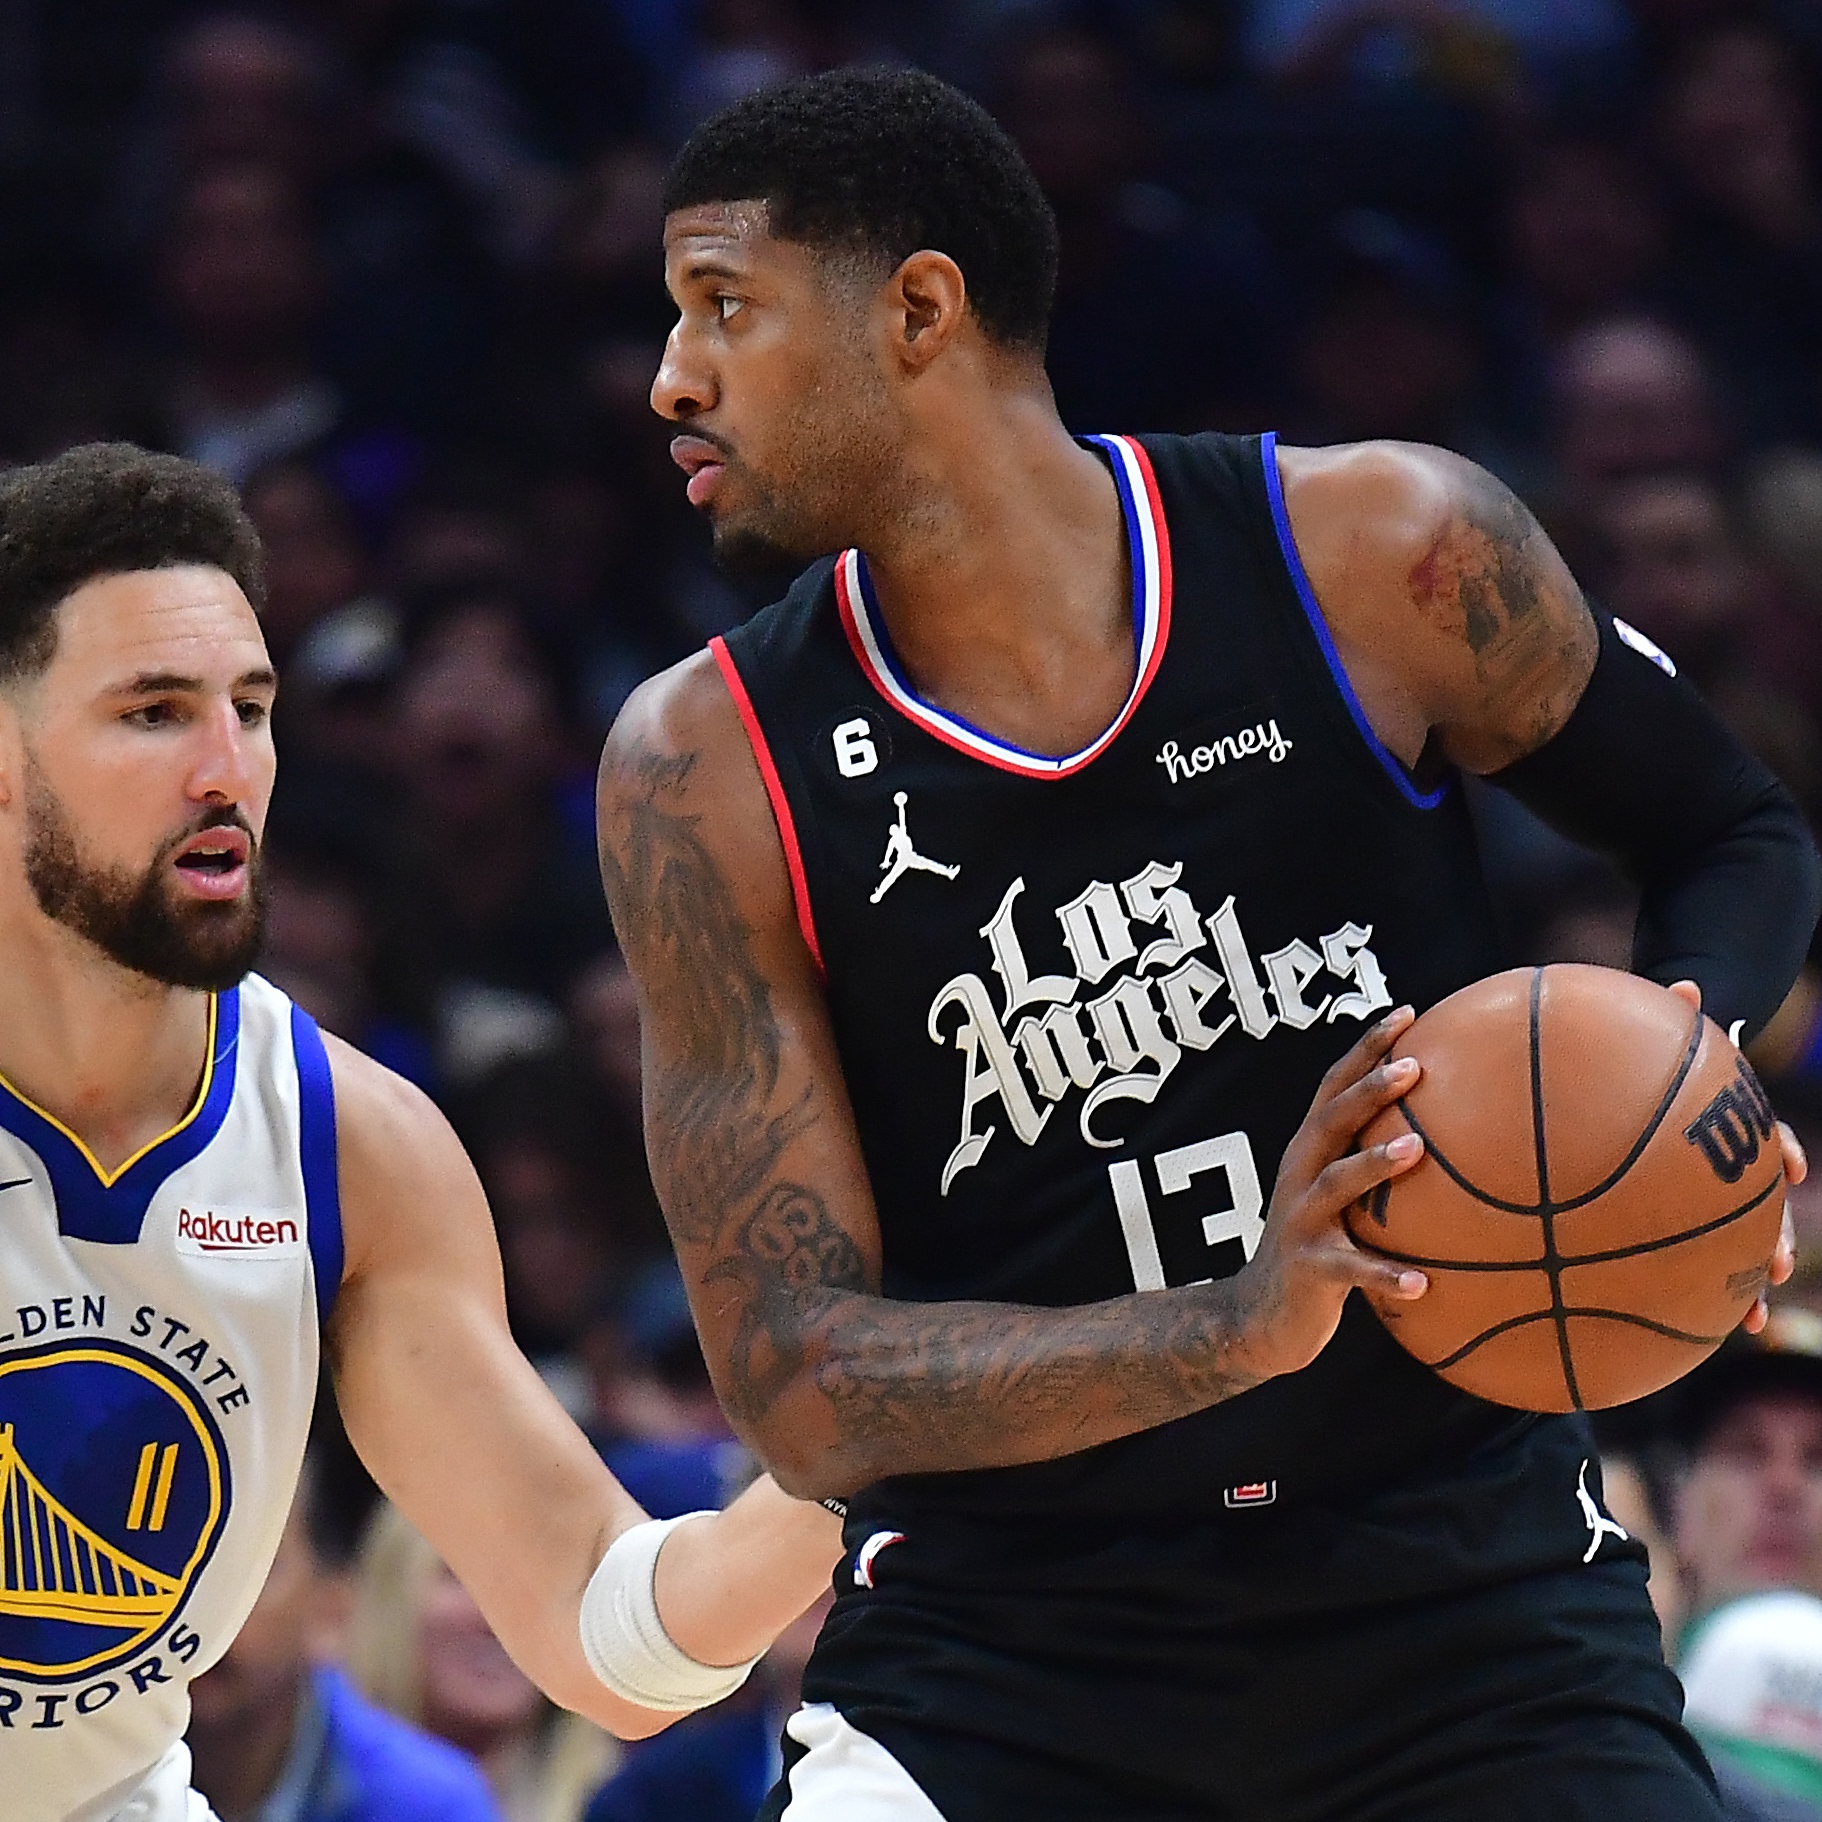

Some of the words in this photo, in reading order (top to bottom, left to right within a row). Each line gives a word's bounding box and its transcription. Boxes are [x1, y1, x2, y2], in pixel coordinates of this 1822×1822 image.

[832, 717, 879, 778] 6
[1155, 718, 1293, 784] honey
[979, 861, 1207, 1027] Los
[928, 895, 1393, 1196] Angeles
[178, 1208, 298, 1244] Rakuten
[1108, 1131, 1265, 1292] 13
[129, 1305, 251, 1416] STATE
[127, 1442, 179, 1532] 11
